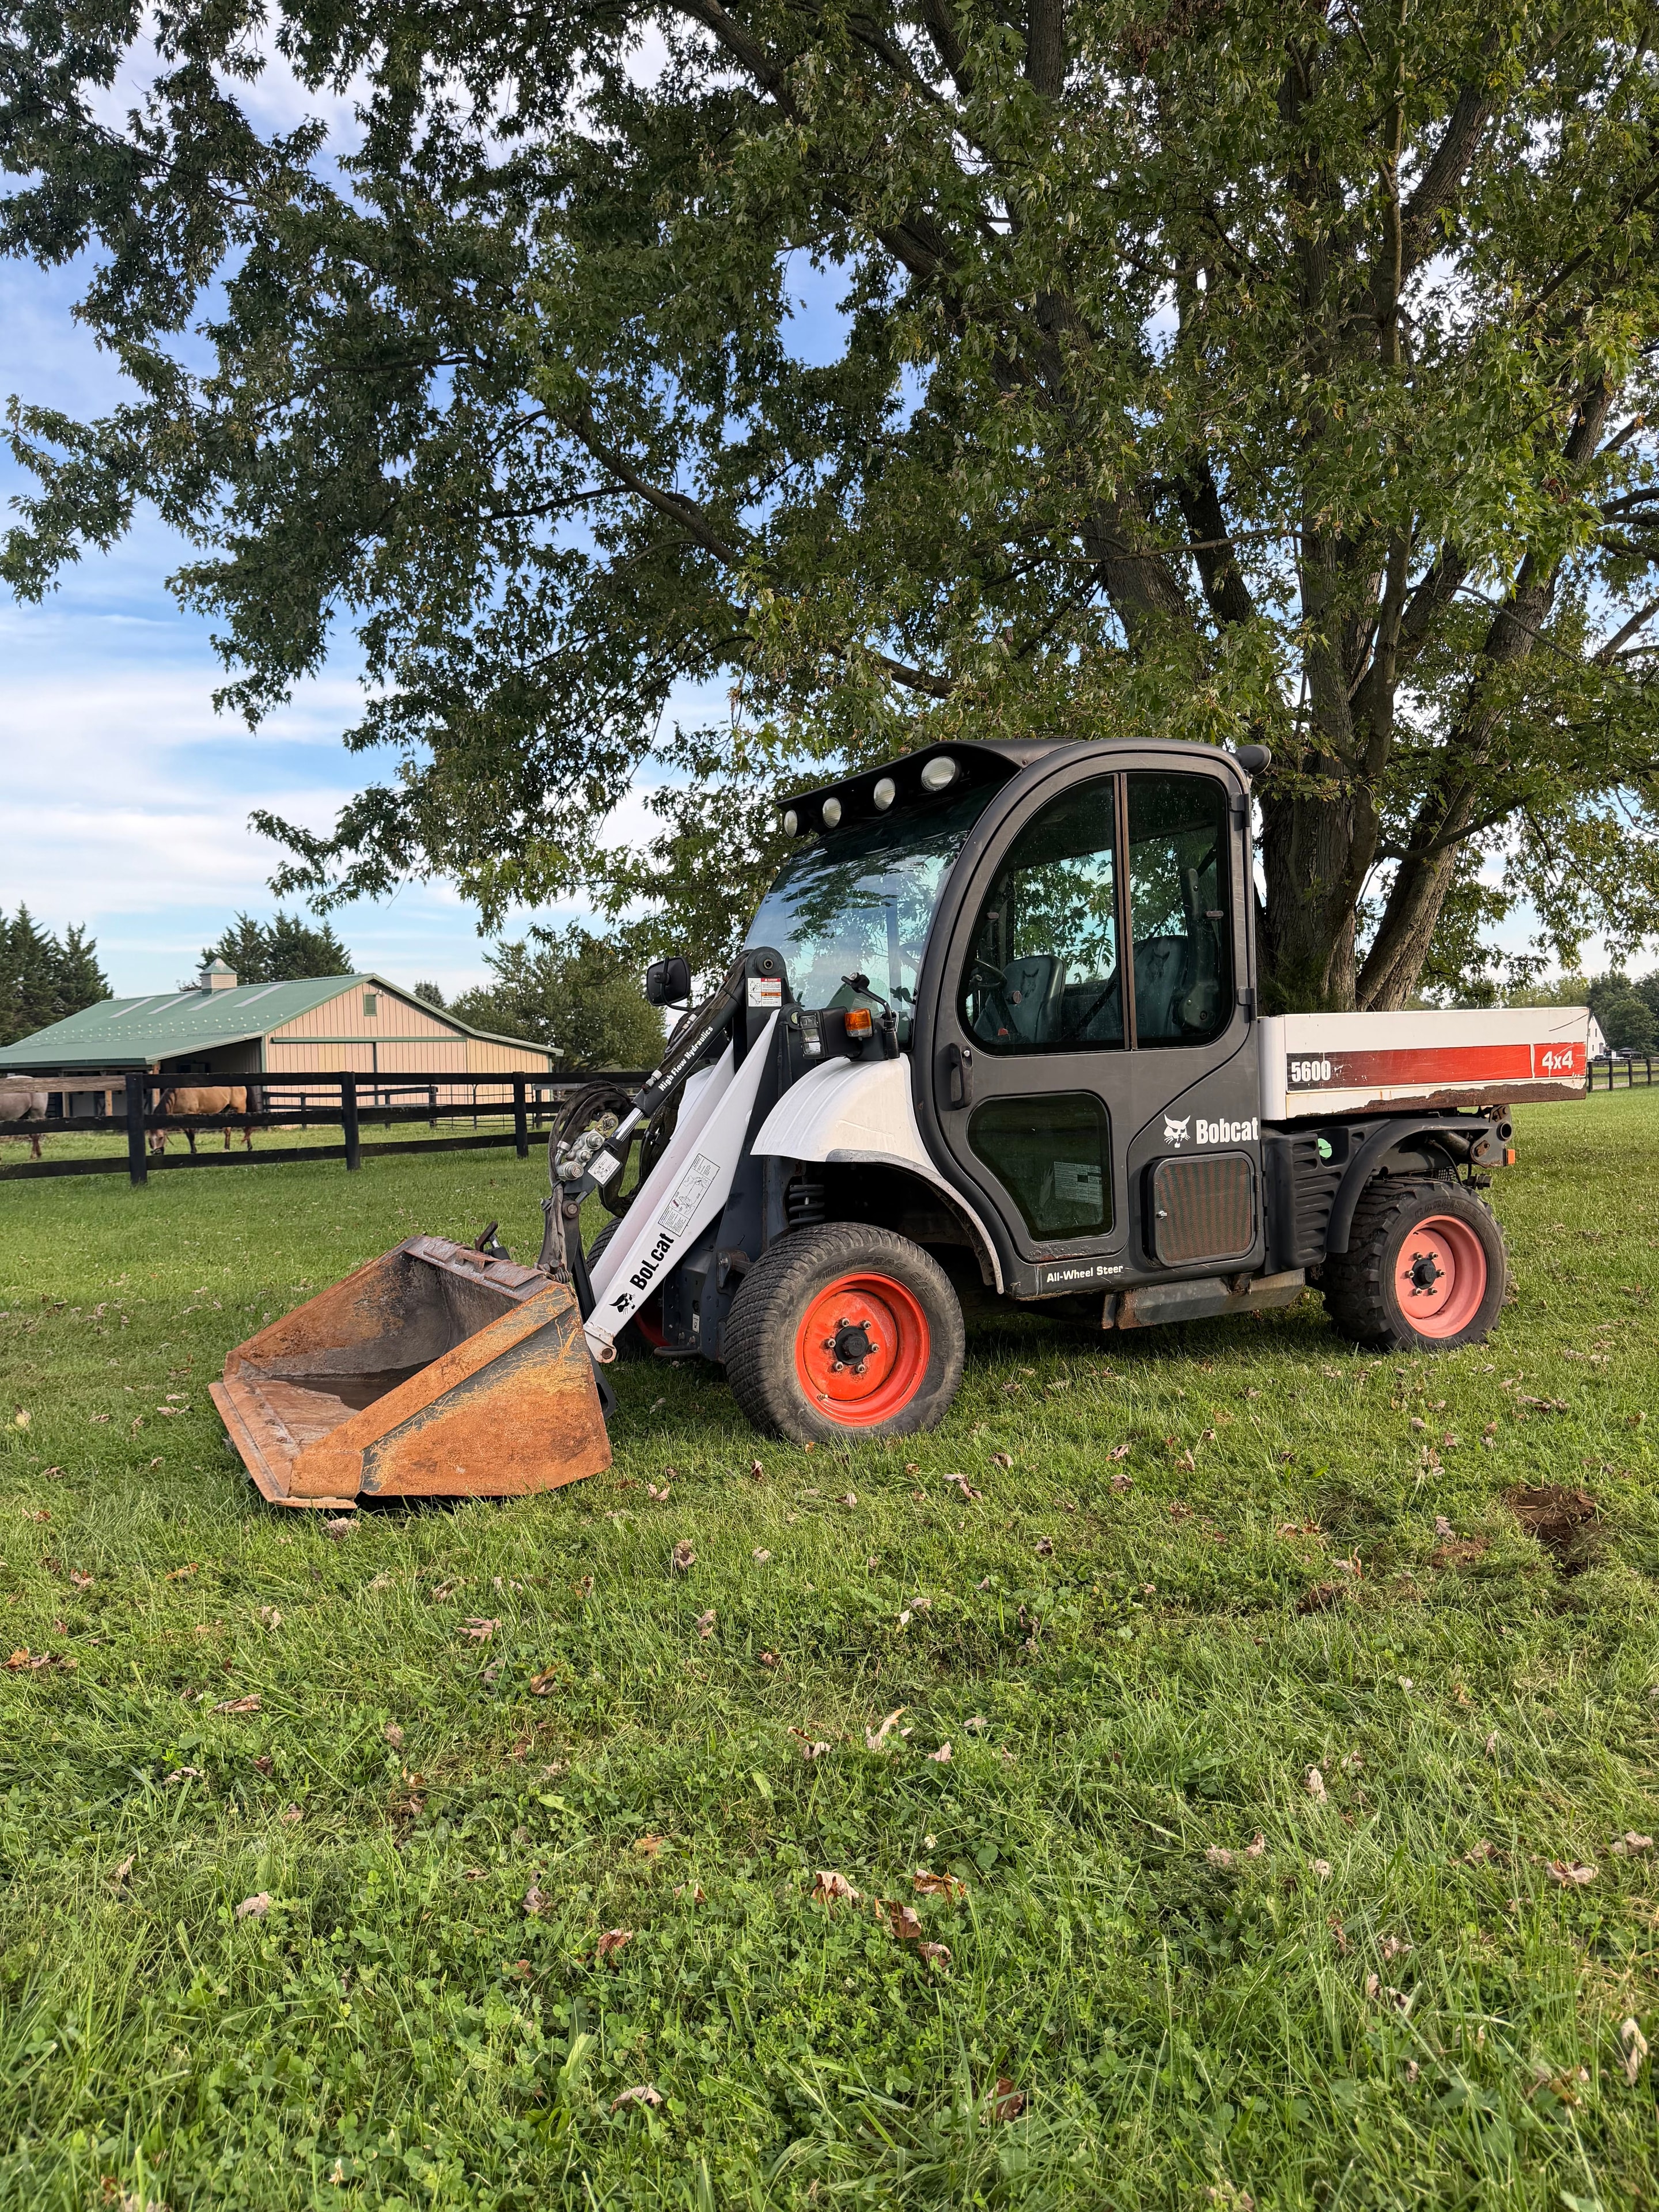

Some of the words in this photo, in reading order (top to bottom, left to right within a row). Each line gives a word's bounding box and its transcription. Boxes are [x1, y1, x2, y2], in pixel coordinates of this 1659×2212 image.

[658, 1075, 674, 1092] High
[671, 1058, 687, 1076] Flow
[684, 1026, 713, 1059] Hydraulics
[1541, 1050, 1573, 1070] 4x4
[1291, 1060, 1331, 1082] 5600
[1196, 1117, 1258, 1145] Bobcat
[1047, 1267, 1093, 1283] All-Wheel
[1096, 1265, 1123, 1276] Steer
